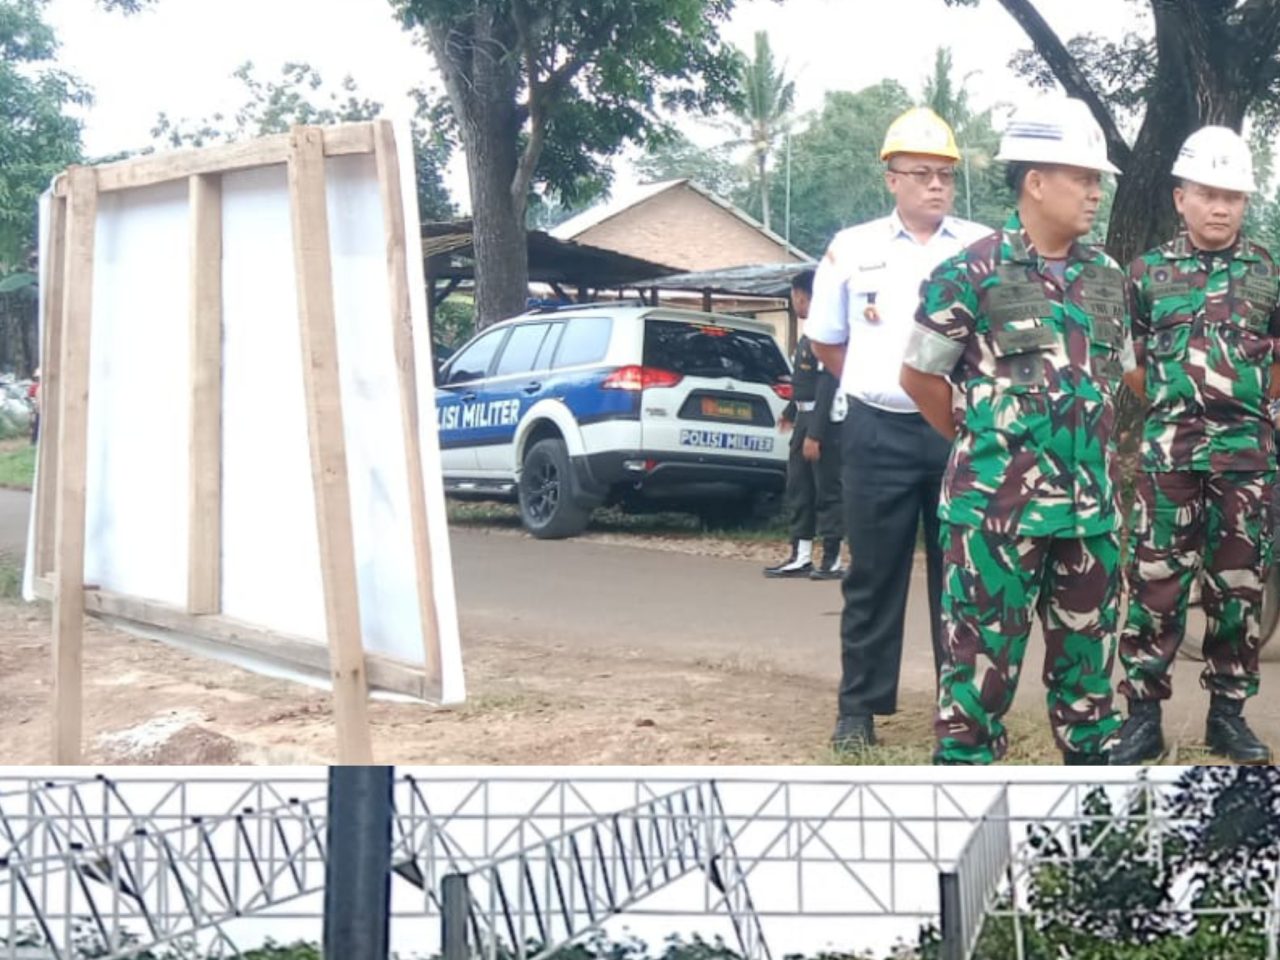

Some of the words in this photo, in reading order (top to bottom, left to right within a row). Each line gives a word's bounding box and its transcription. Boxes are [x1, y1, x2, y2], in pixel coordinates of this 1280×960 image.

[462, 399, 520, 428] MILITER
[681, 429, 723, 448] POLISI
[726, 432, 773, 452] MILITER
